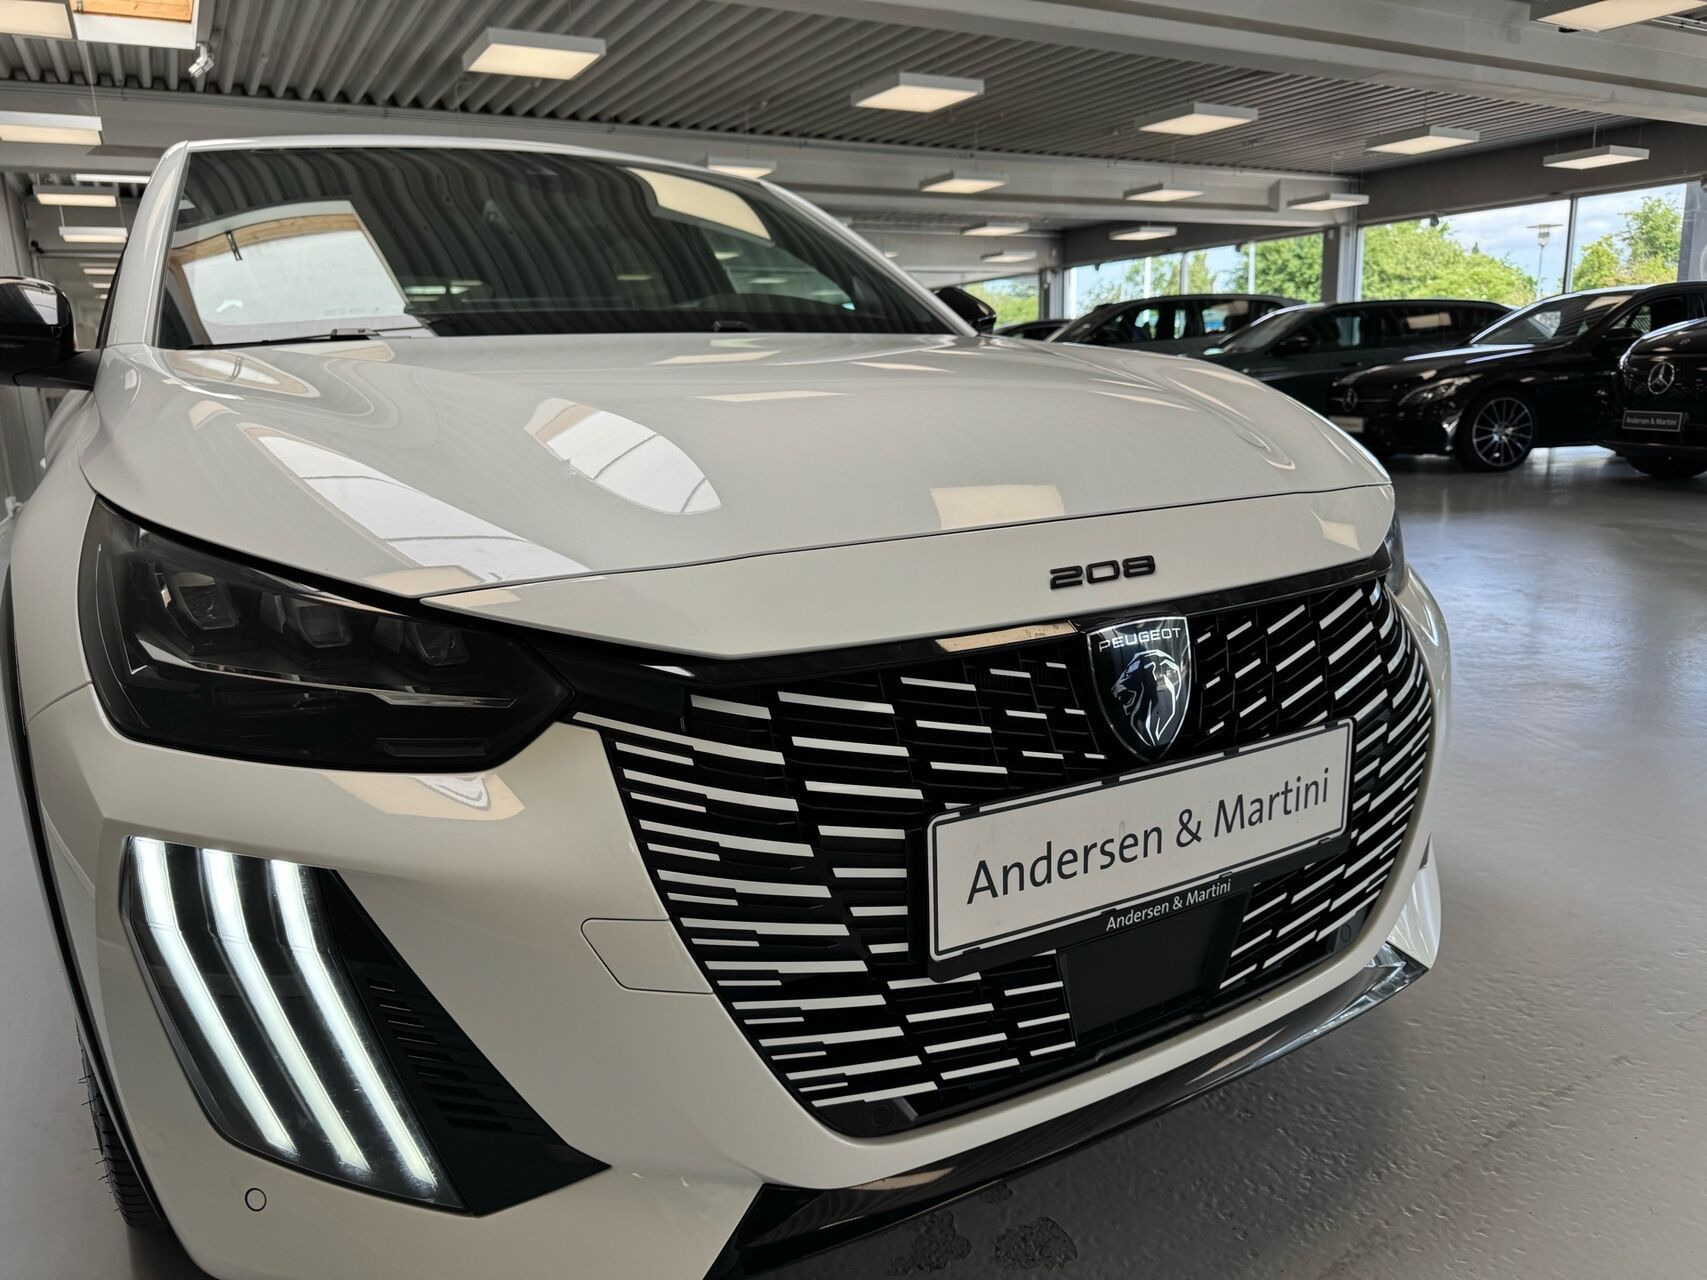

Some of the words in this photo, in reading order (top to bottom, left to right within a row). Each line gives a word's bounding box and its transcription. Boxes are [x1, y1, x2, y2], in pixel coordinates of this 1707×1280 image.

[1050, 555, 1156, 590] 208
[1099, 627, 1181, 652] PEUGEOT
[966, 824, 1162, 905] Andersen
[1176, 808, 1202, 848] &
[1213, 767, 1329, 838] Martini
[1106, 901, 1170, 932] Andersen
[1172, 896, 1183, 911] &
[1186, 879, 1232, 906] Martini
